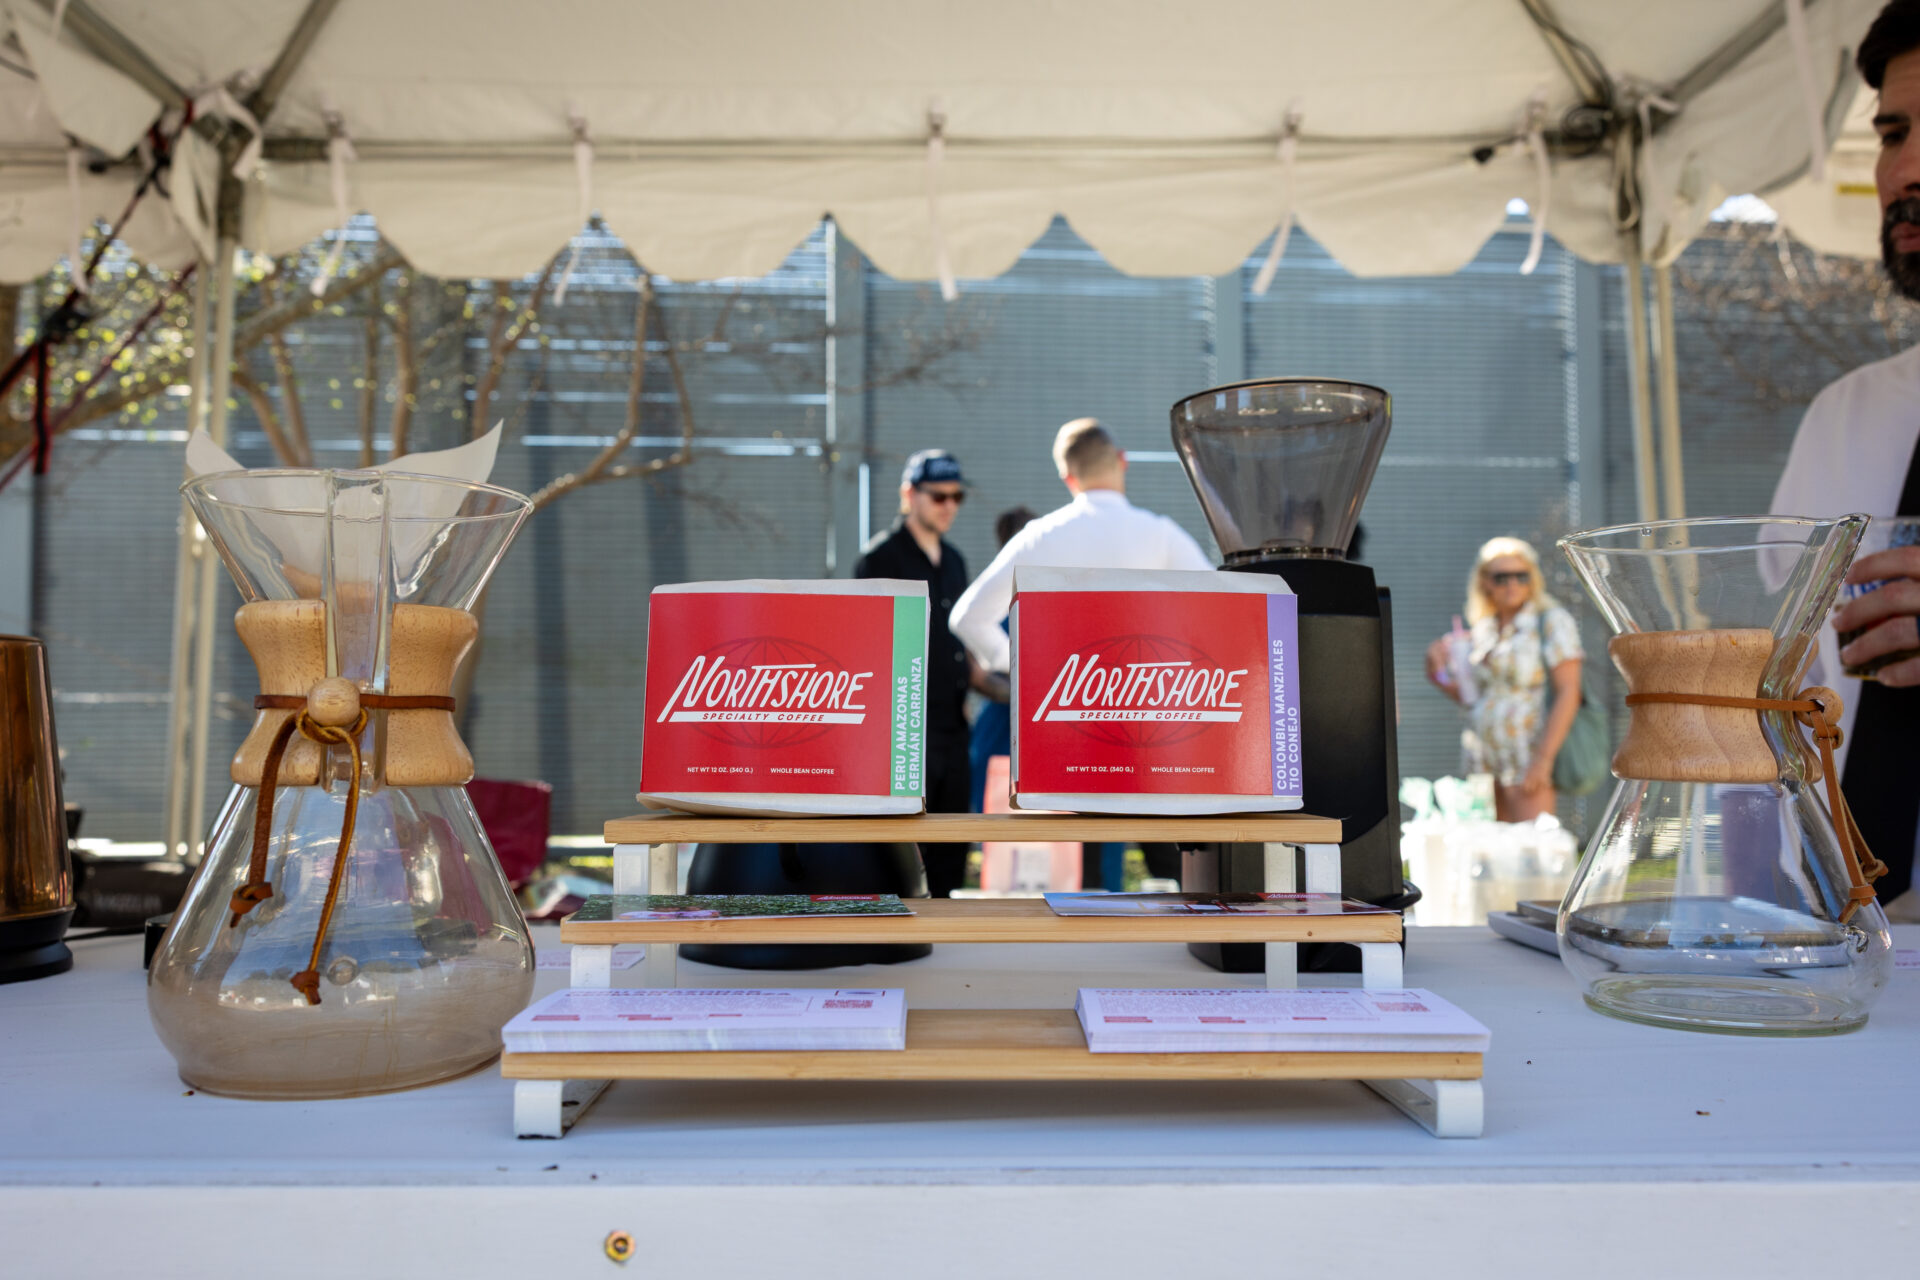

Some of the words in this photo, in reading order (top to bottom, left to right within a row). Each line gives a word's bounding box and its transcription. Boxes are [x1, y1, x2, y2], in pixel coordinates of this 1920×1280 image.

[909, 656, 922, 728] CARRANZA
[1273, 639, 1285, 714] MANZIALES
[702, 712, 770, 721] SPECIALTY
[777, 713, 825, 722] COFFEE
[896, 676, 908, 751] AMAZONAS
[1079, 711, 1148, 720] SPECIALTY
[1155, 712, 1203, 721] COFFEE
[1287, 707, 1298, 763] CONEJO
[729, 766, 744, 774] (340
[895, 755, 906, 790] PERU
[907, 732, 920, 791] GERMÁN
[1110, 766, 1124, 774] (340
[1275, 718, 1287, 790] COLOMBIA
[1289, 767, 1299, 790] TIO
